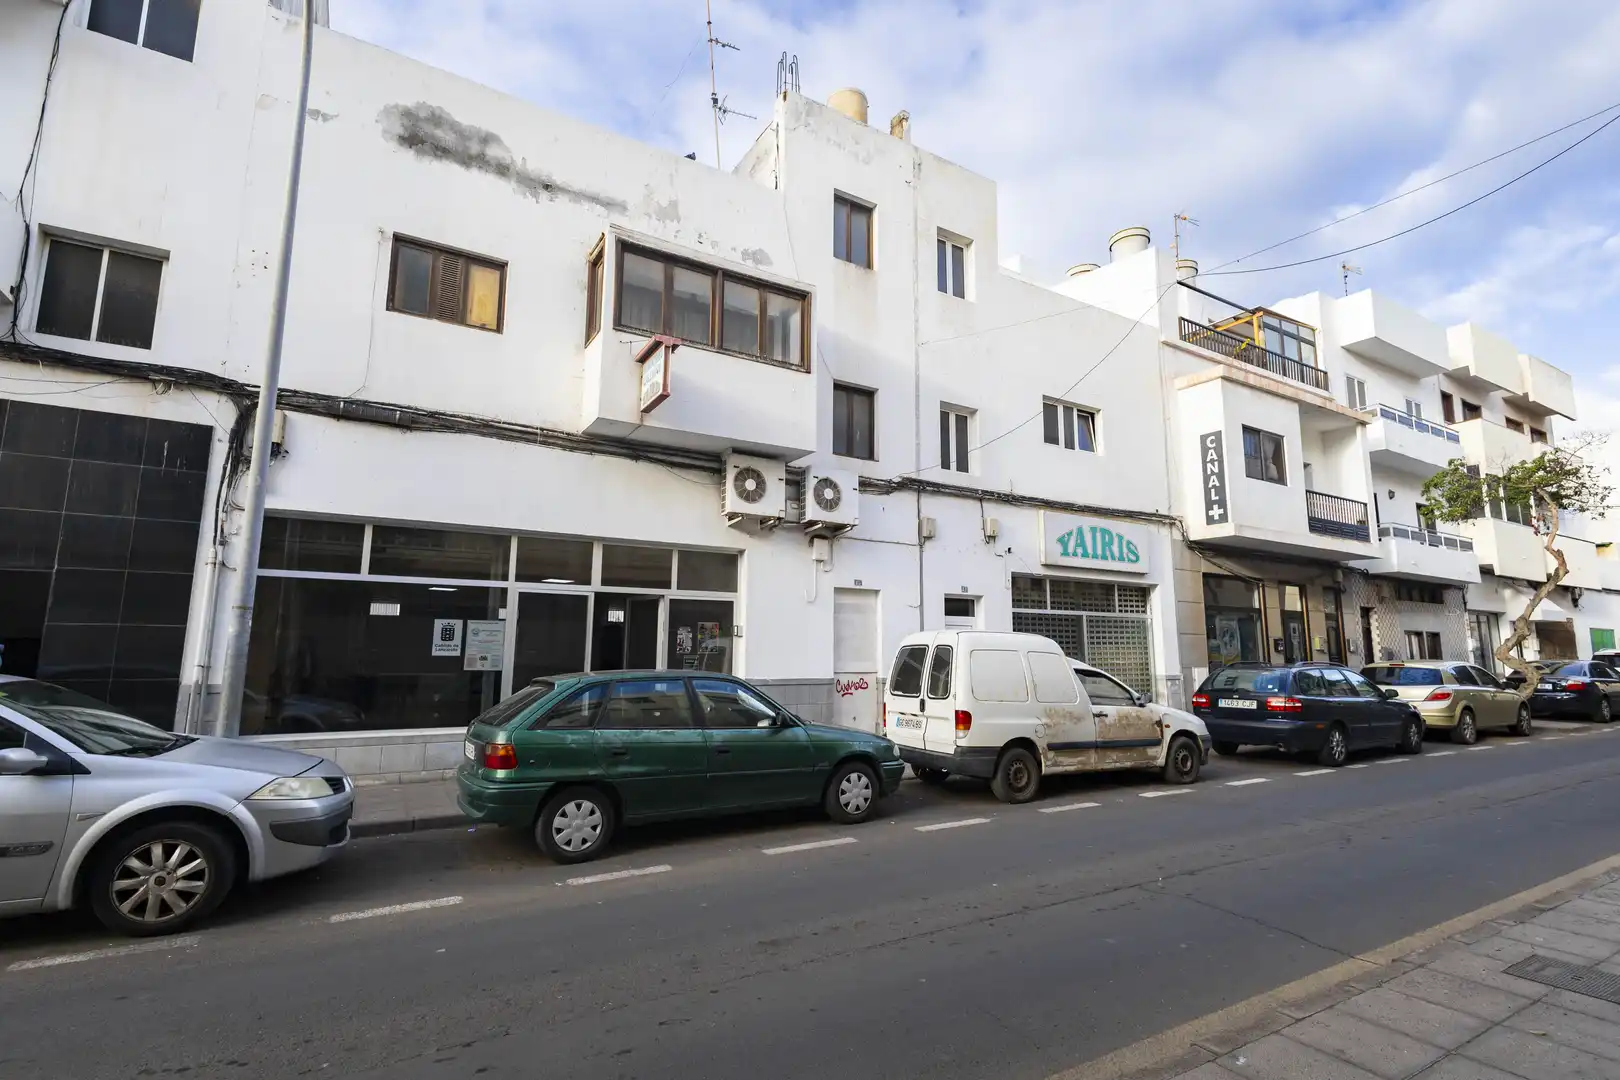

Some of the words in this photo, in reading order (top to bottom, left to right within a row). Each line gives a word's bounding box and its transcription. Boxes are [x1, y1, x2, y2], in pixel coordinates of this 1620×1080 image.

[1056, 524, 1140, 563] YAIRIS
[1223, 699, 1239, 707] 1463
[1241, 700, 1255, 708] CJF
